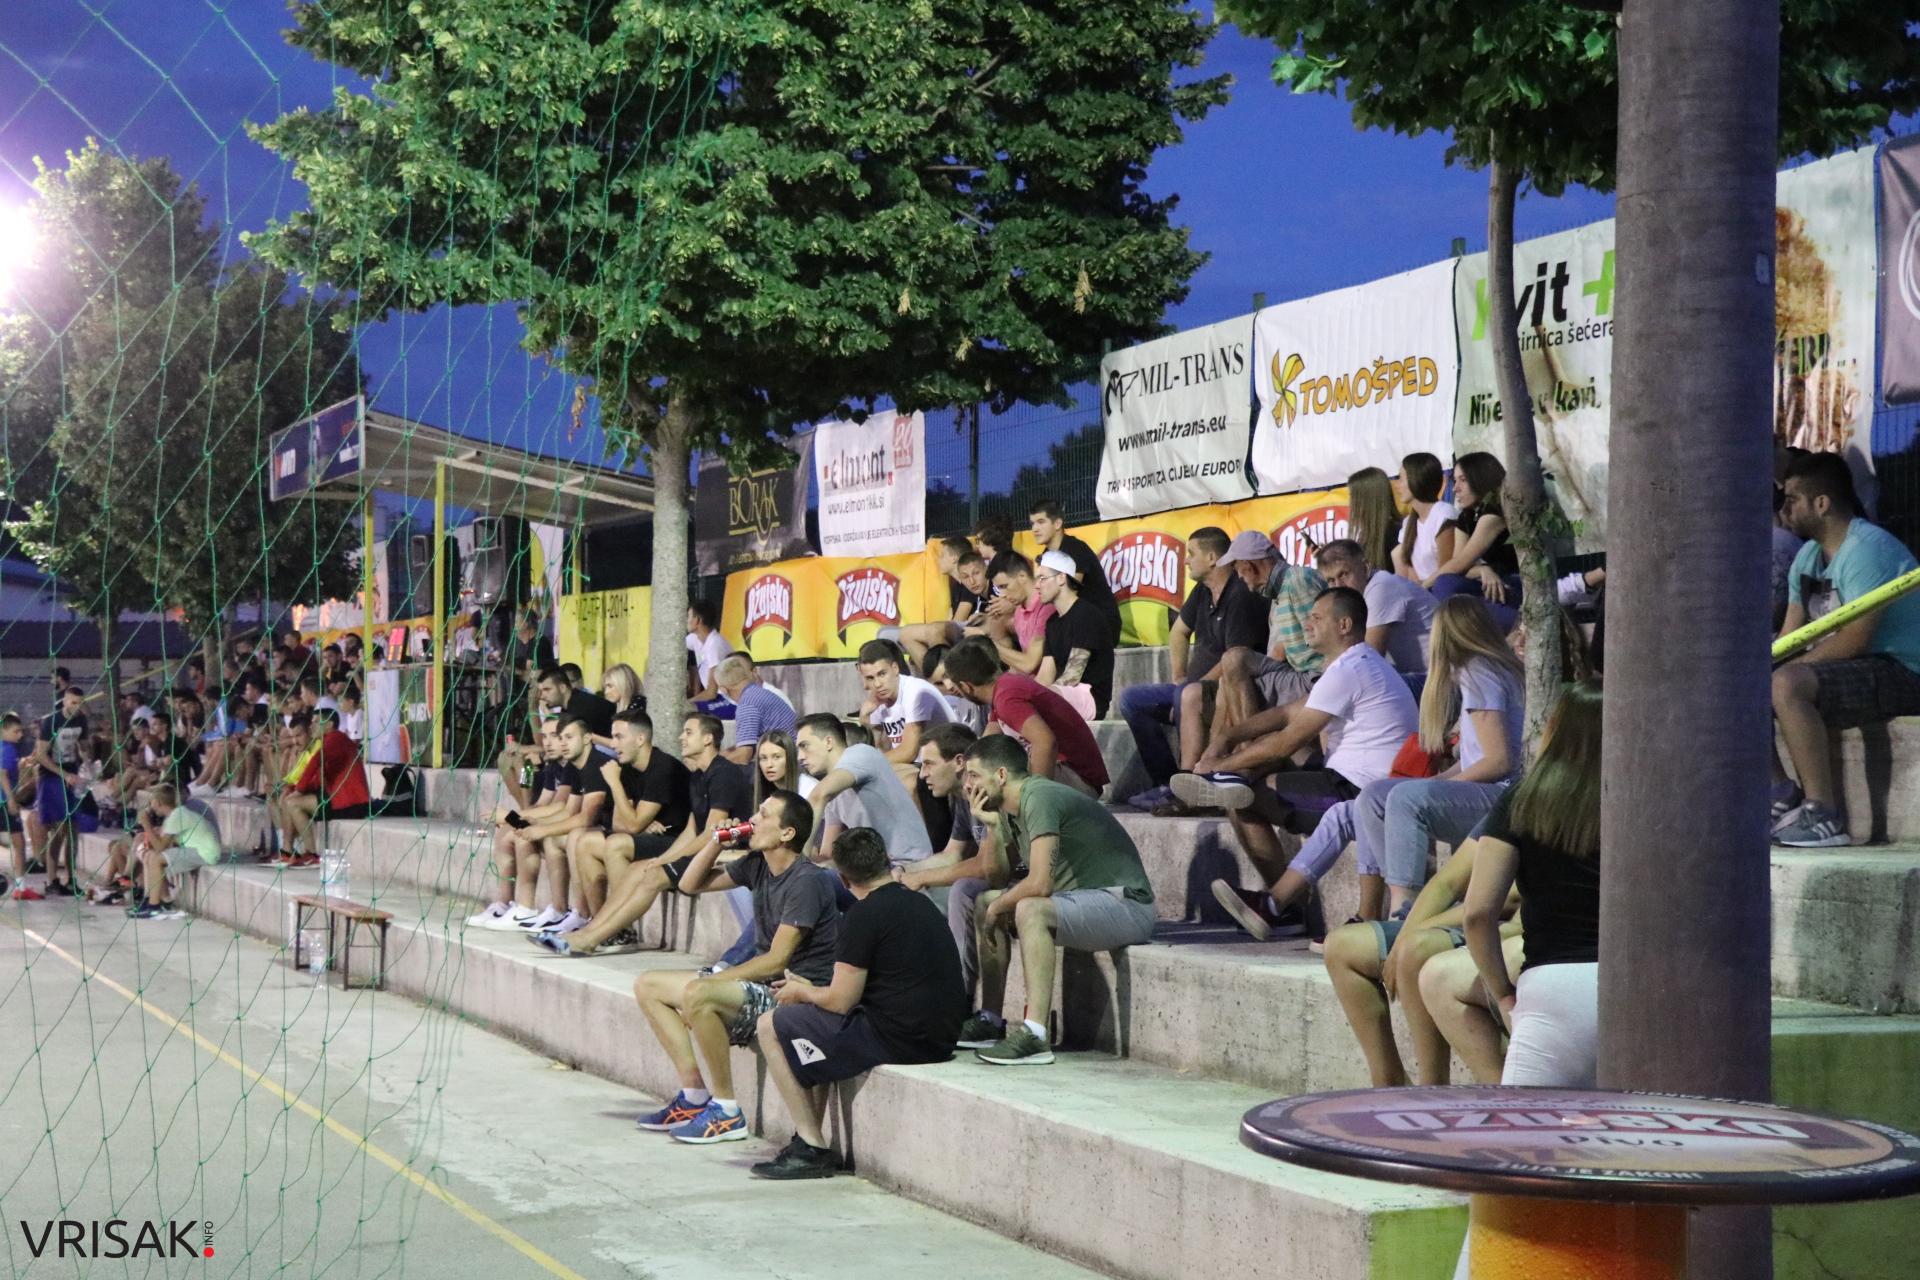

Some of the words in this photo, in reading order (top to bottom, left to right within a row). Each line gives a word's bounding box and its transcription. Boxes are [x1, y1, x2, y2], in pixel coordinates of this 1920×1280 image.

[1139, 343, 1244, 397] MIL-TRANS
[1300, 355, 1438, 415] TOMOŠPED
[1118, 414, 1227, 452] www.mil-trans.eu
